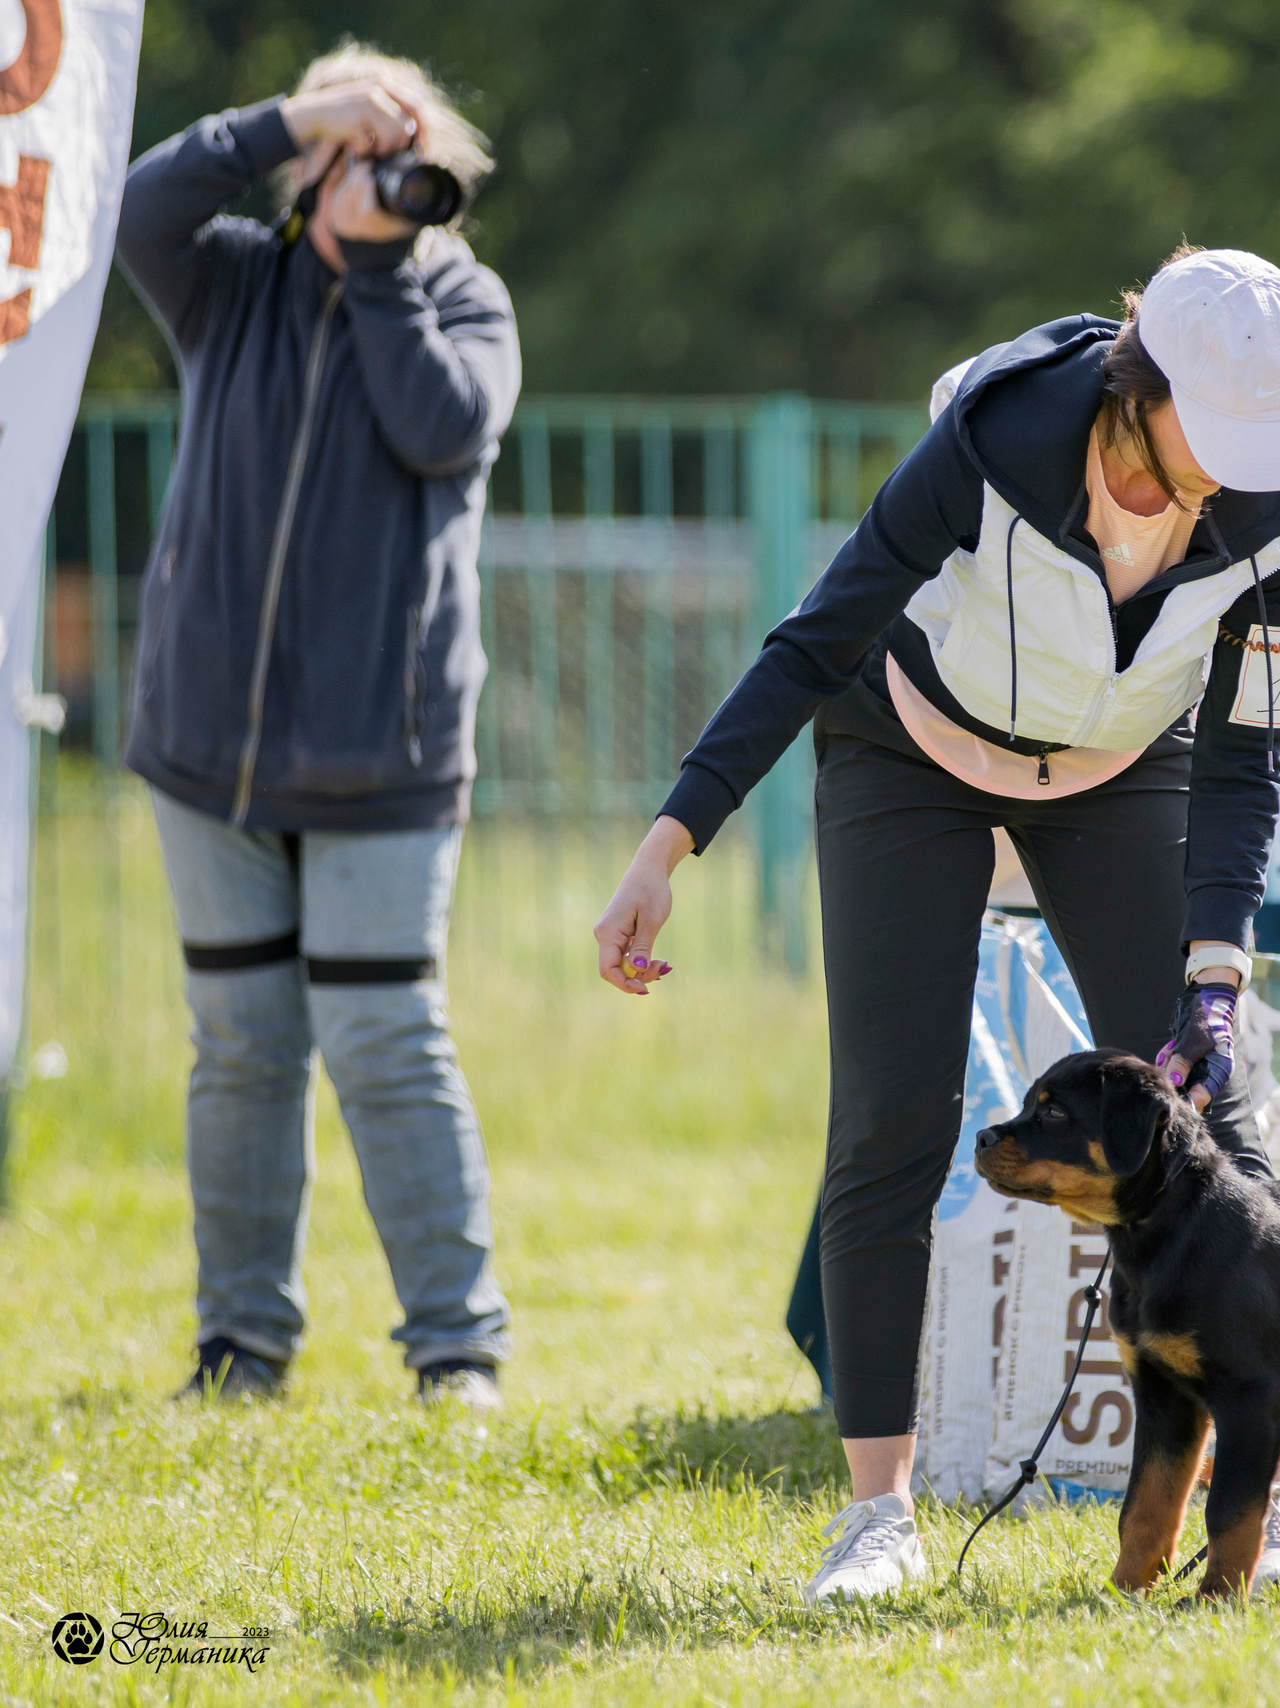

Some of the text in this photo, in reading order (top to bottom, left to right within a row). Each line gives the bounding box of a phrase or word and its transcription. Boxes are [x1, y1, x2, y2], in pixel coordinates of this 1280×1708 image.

[1101, 549, 1135, 567] adidas
[937, 1265, 948, 1332] РИСОМ
[1004, 1337, 1019, 1422] ЯГНЕНОК
[1012, 1245, 1026, 1314] РИСОМ
[933, 1354, 945, 1436] ЯГНЕНОК
[1056, 1459, 1129, 1475] PREMIUM
